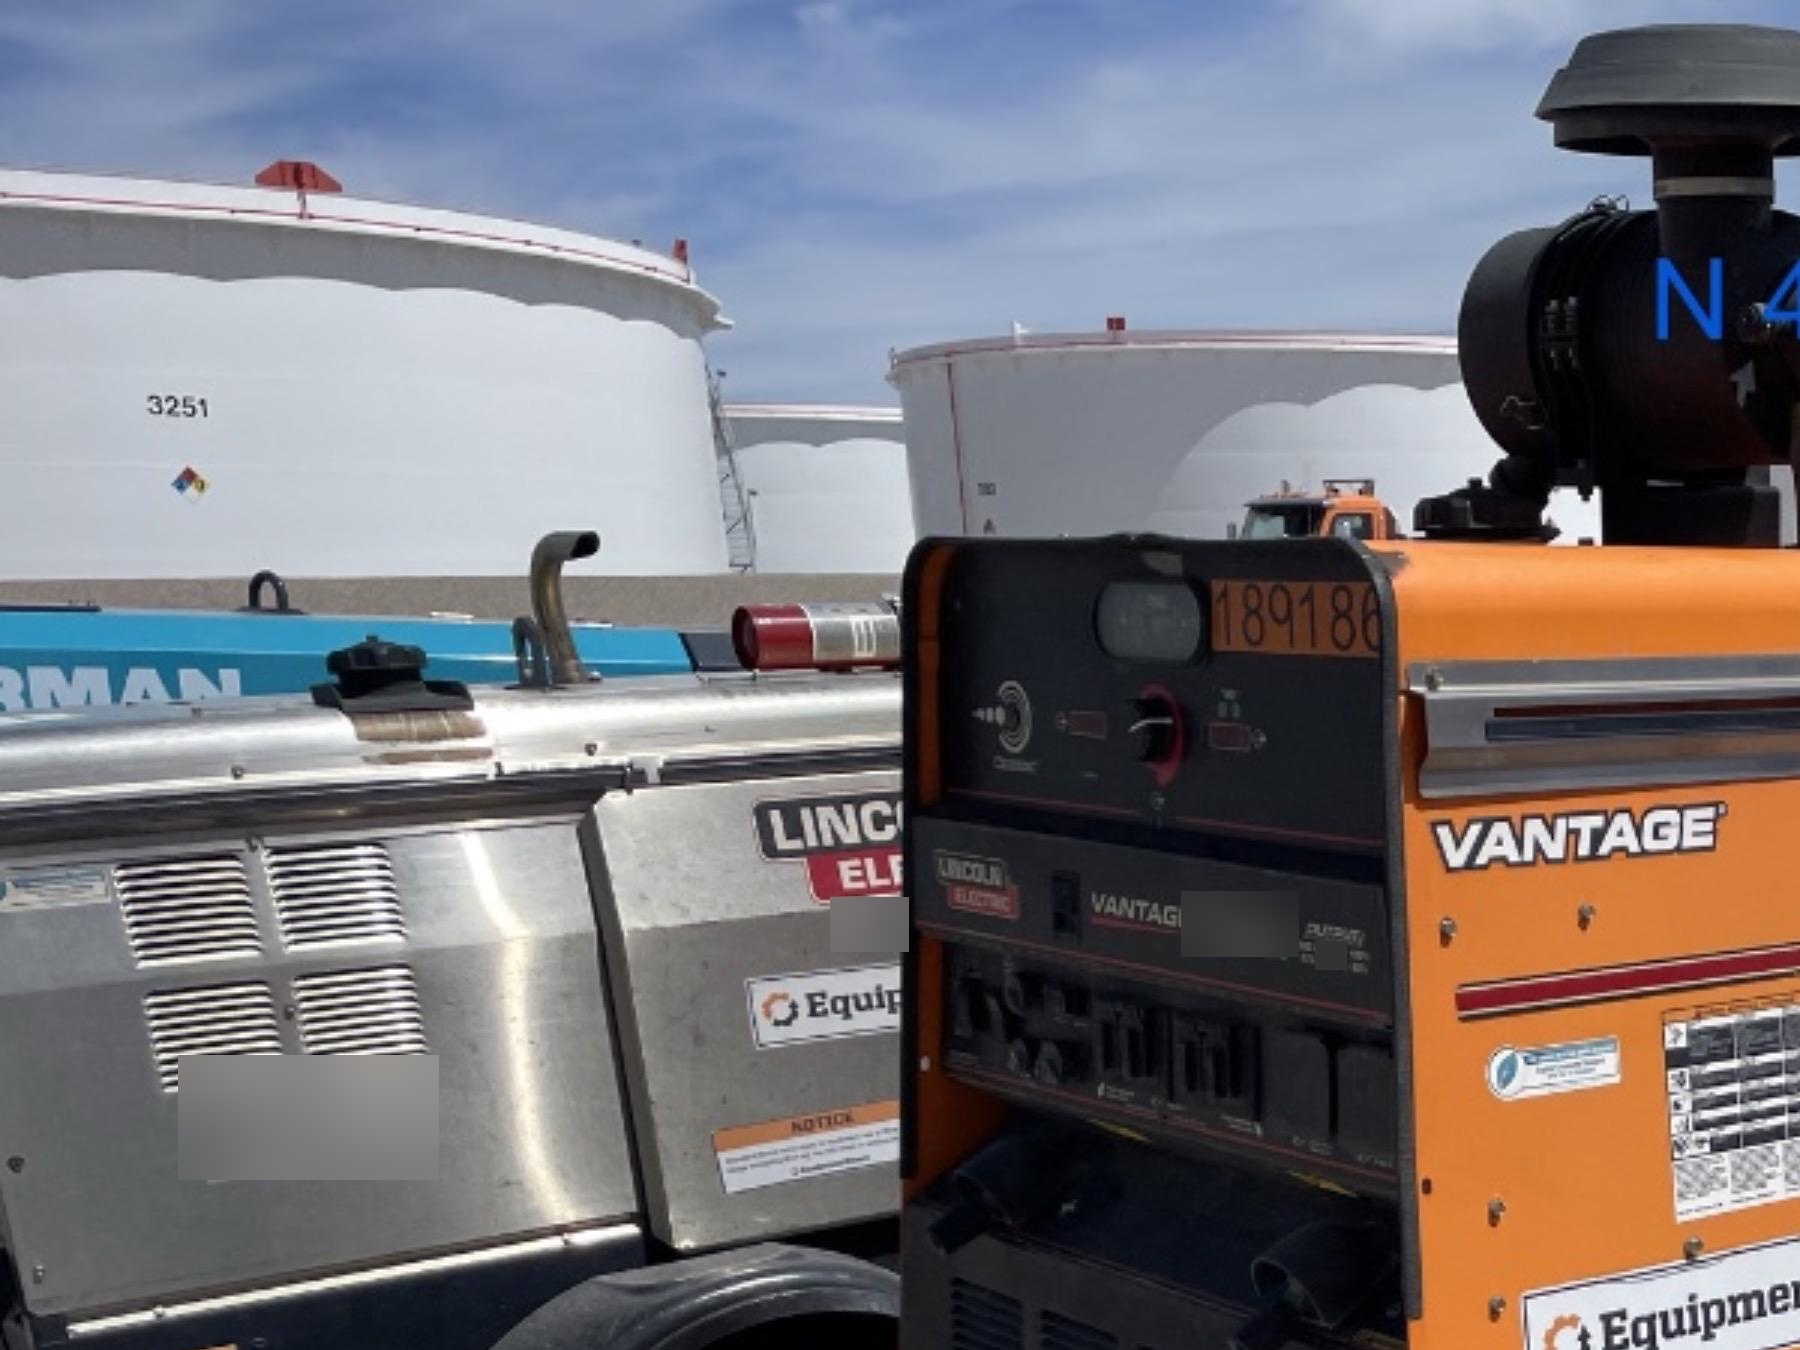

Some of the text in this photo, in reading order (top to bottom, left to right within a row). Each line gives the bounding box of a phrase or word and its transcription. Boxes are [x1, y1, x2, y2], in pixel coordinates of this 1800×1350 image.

[147, 394, 208, 418] 3251
[1214, 583, 1381, 651] 189186
[769, 800, 903, 850] LINC
[1434, 804, 1719, 870] VANTAGE
[938, 857, 1004, 887] LINCOLN
[1091, 893, 1181, 929] VANTAG
